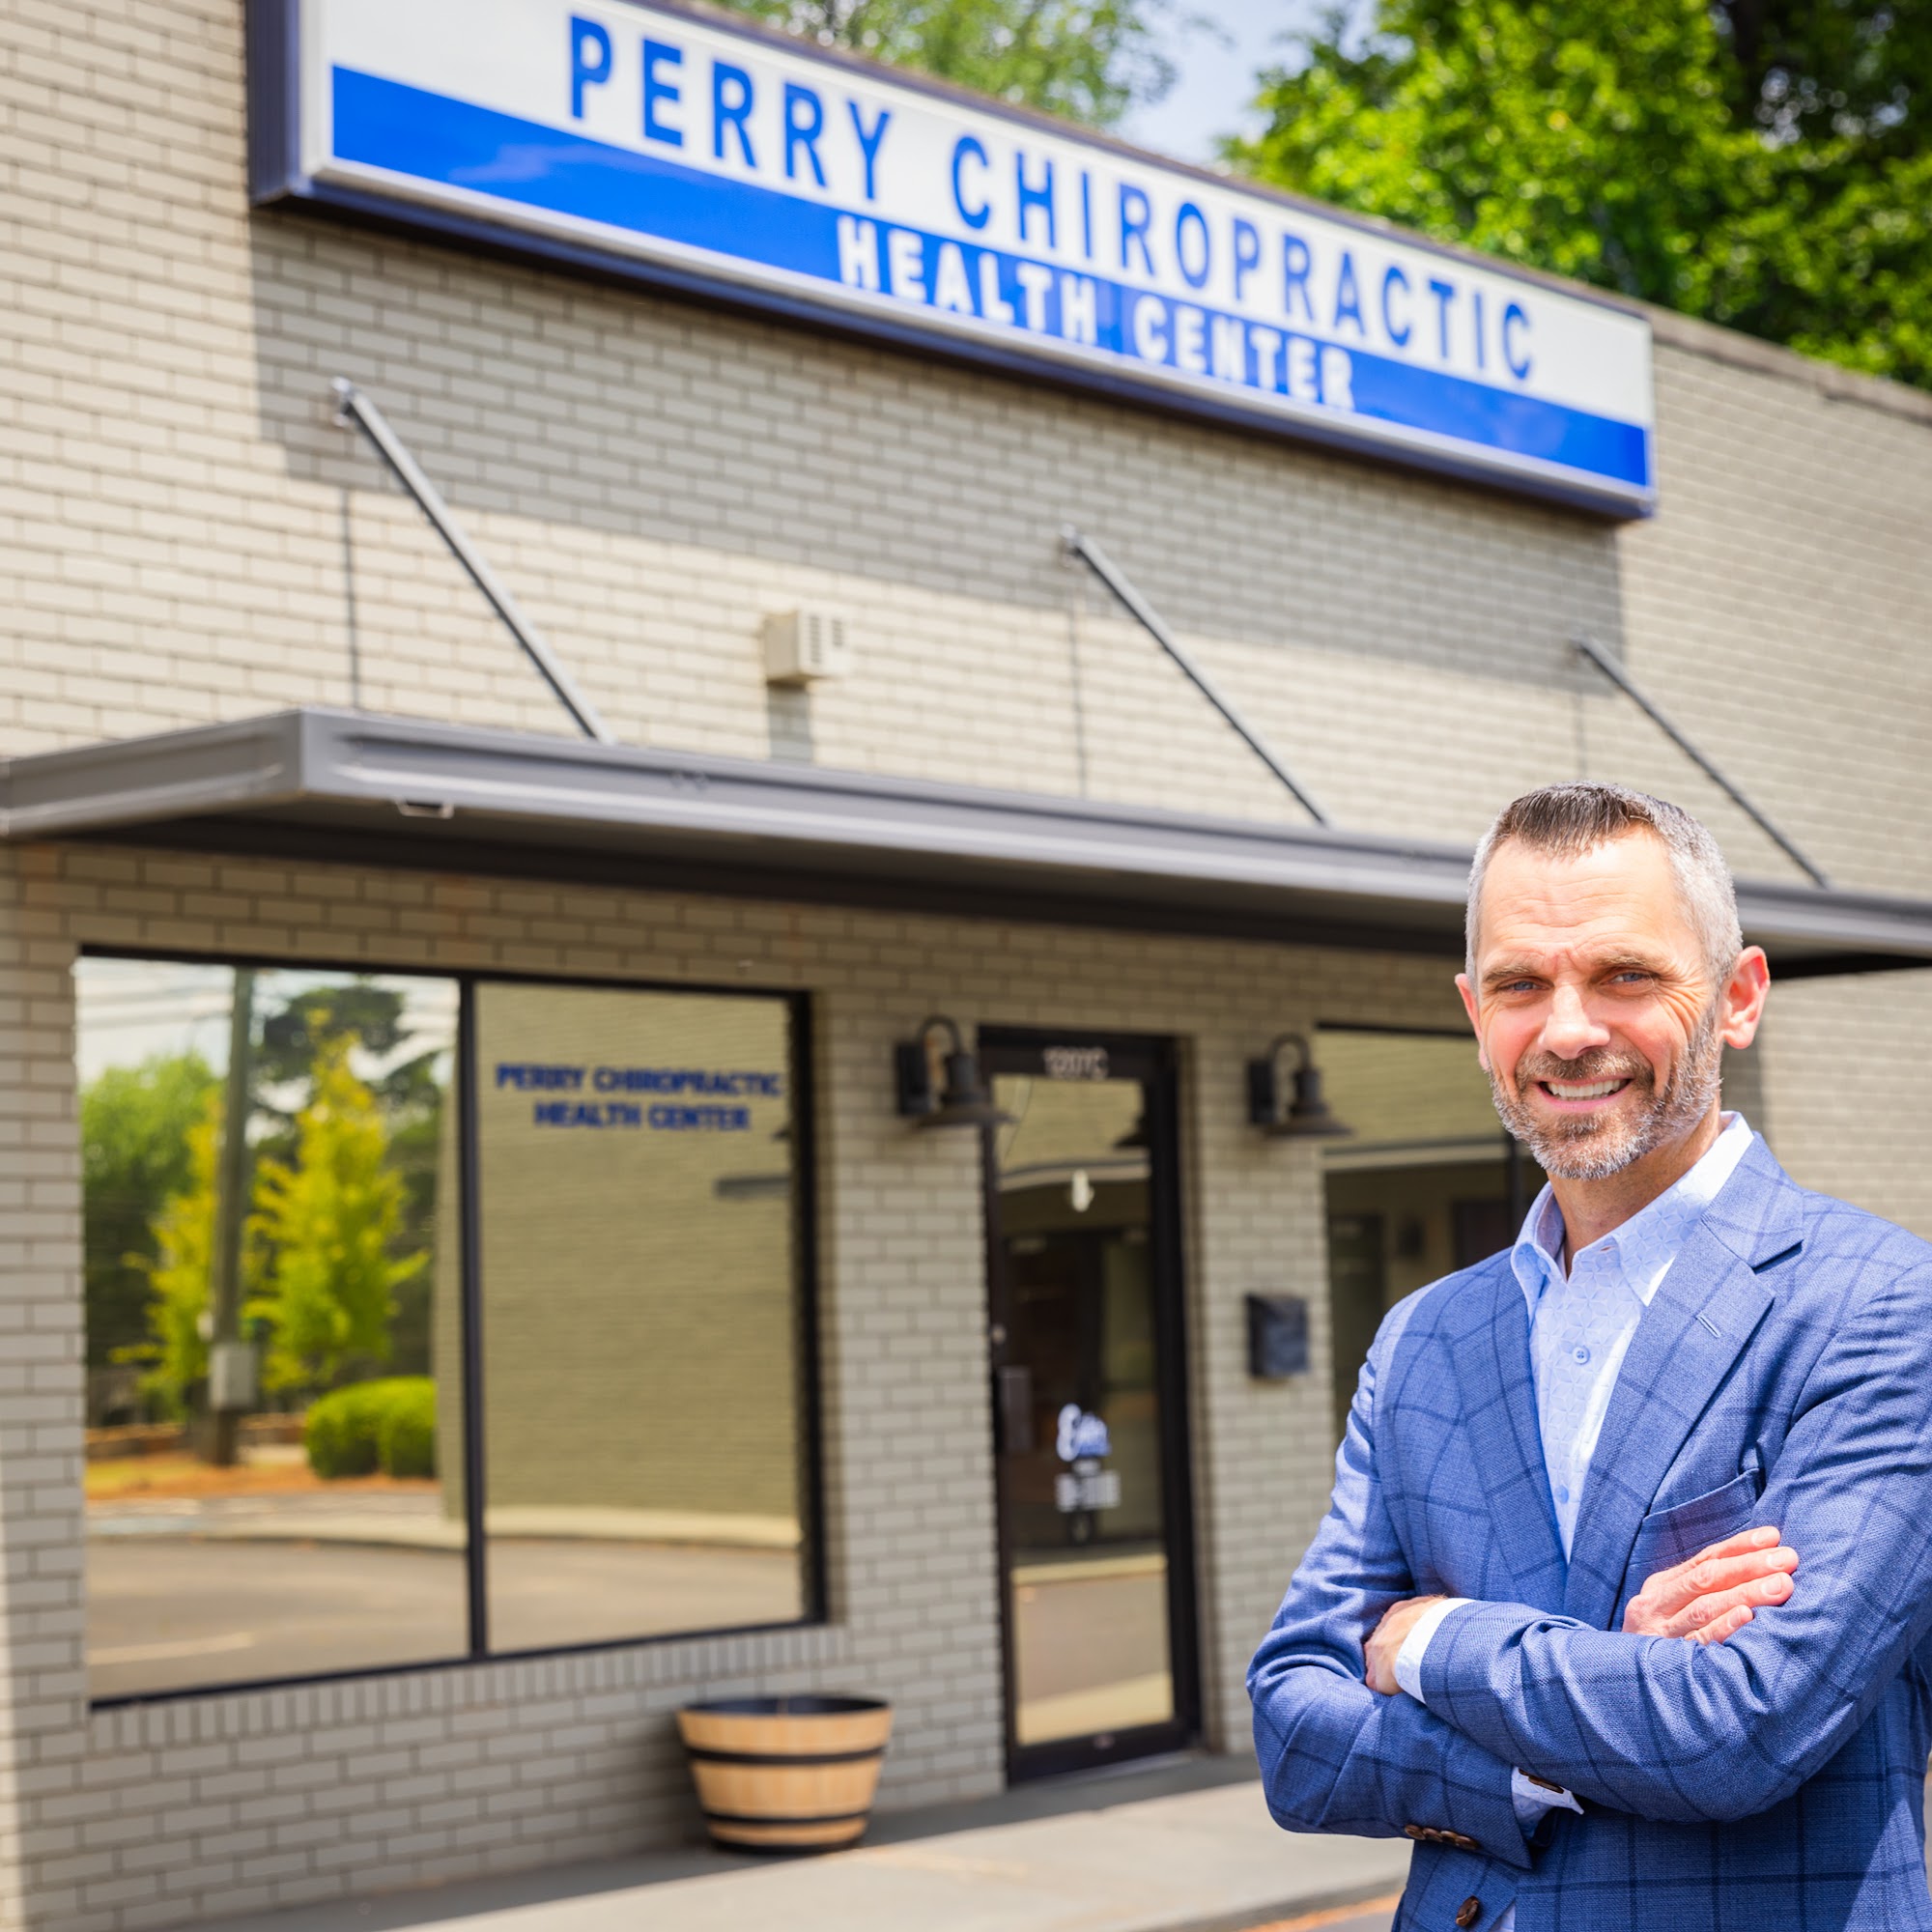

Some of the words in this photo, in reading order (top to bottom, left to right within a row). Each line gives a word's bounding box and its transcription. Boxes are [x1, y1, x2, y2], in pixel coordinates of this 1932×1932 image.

[569, 14, 892, 202] PERRY
[952, 134, 1534, 382] CHIROPRACTIC
[837, 214, 1098, 346] HEALTH
[1132, 293, 1355, 412] CENTER
[496, 1064, 584, 1091] PERRY
[593, 1066, 781, 1095] CHIROPRACTIC
[534, 1101, 641, 1128] HEALTH
[649, 1104, 750, 1131] CENTER
